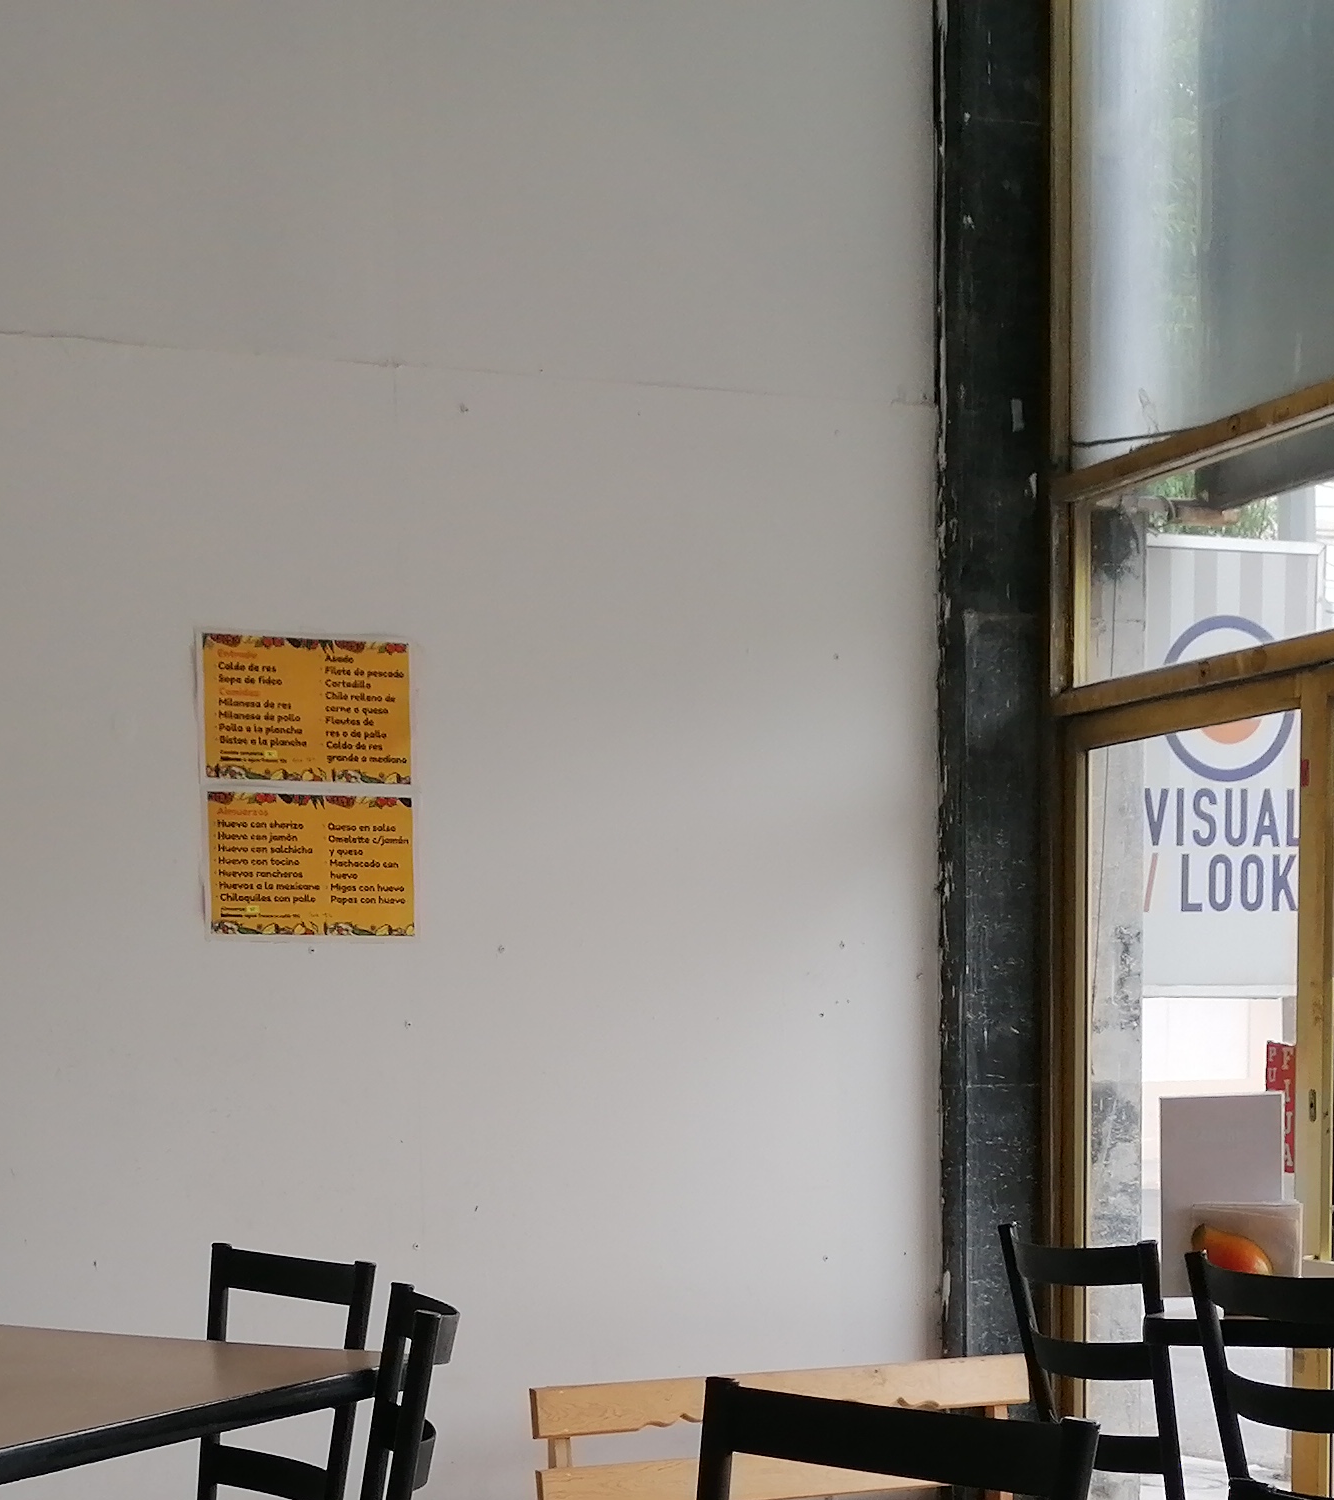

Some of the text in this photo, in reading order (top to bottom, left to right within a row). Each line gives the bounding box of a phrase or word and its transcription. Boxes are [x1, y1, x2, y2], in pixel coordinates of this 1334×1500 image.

[218, 662, 245, 672] Caldo
[249, 664, 259, 672] de
[325, 667, 351, 676] Filete
[367, 670, 404, 680] pescado
[219, 675, 241, 685] Sopa
[244, 676, 256, 684] de
[326, 692, 348, 701] Chile
[351, 693, 382, 702] relleno
[219, 699, 261, 708] Milanesa
[219, 712, 300, 723] Milanesa de pollo
[363, 718, 374, 726] de
[219, 724, 243, 732] Pollo
[265, 725, 302, 735] plancha
[364, 731, 387, 740] pollo
[270, 737, 307, 748] plancha
[326, 742, 352, 750] Caldo
[327, 755, 358, 763] grande
[1145, 788, 1299, 847] VISUAL
[218, 820, 248, 828] Huevo
[270, 821, 304, 830] chorizo
[328, 823, 356, 832] Queso
[218, 832, 248, 841] Huevo
[218, 845, 248, 853] Huevo
[270, 846, 312, 854] salchicha
[218, 857, 248, 865] Huevo
[219, 870, 303, 878] Huevos rancheros
[330, 872, 358, 880] huevo
[1181, 854, 1299, 911] LOOK
